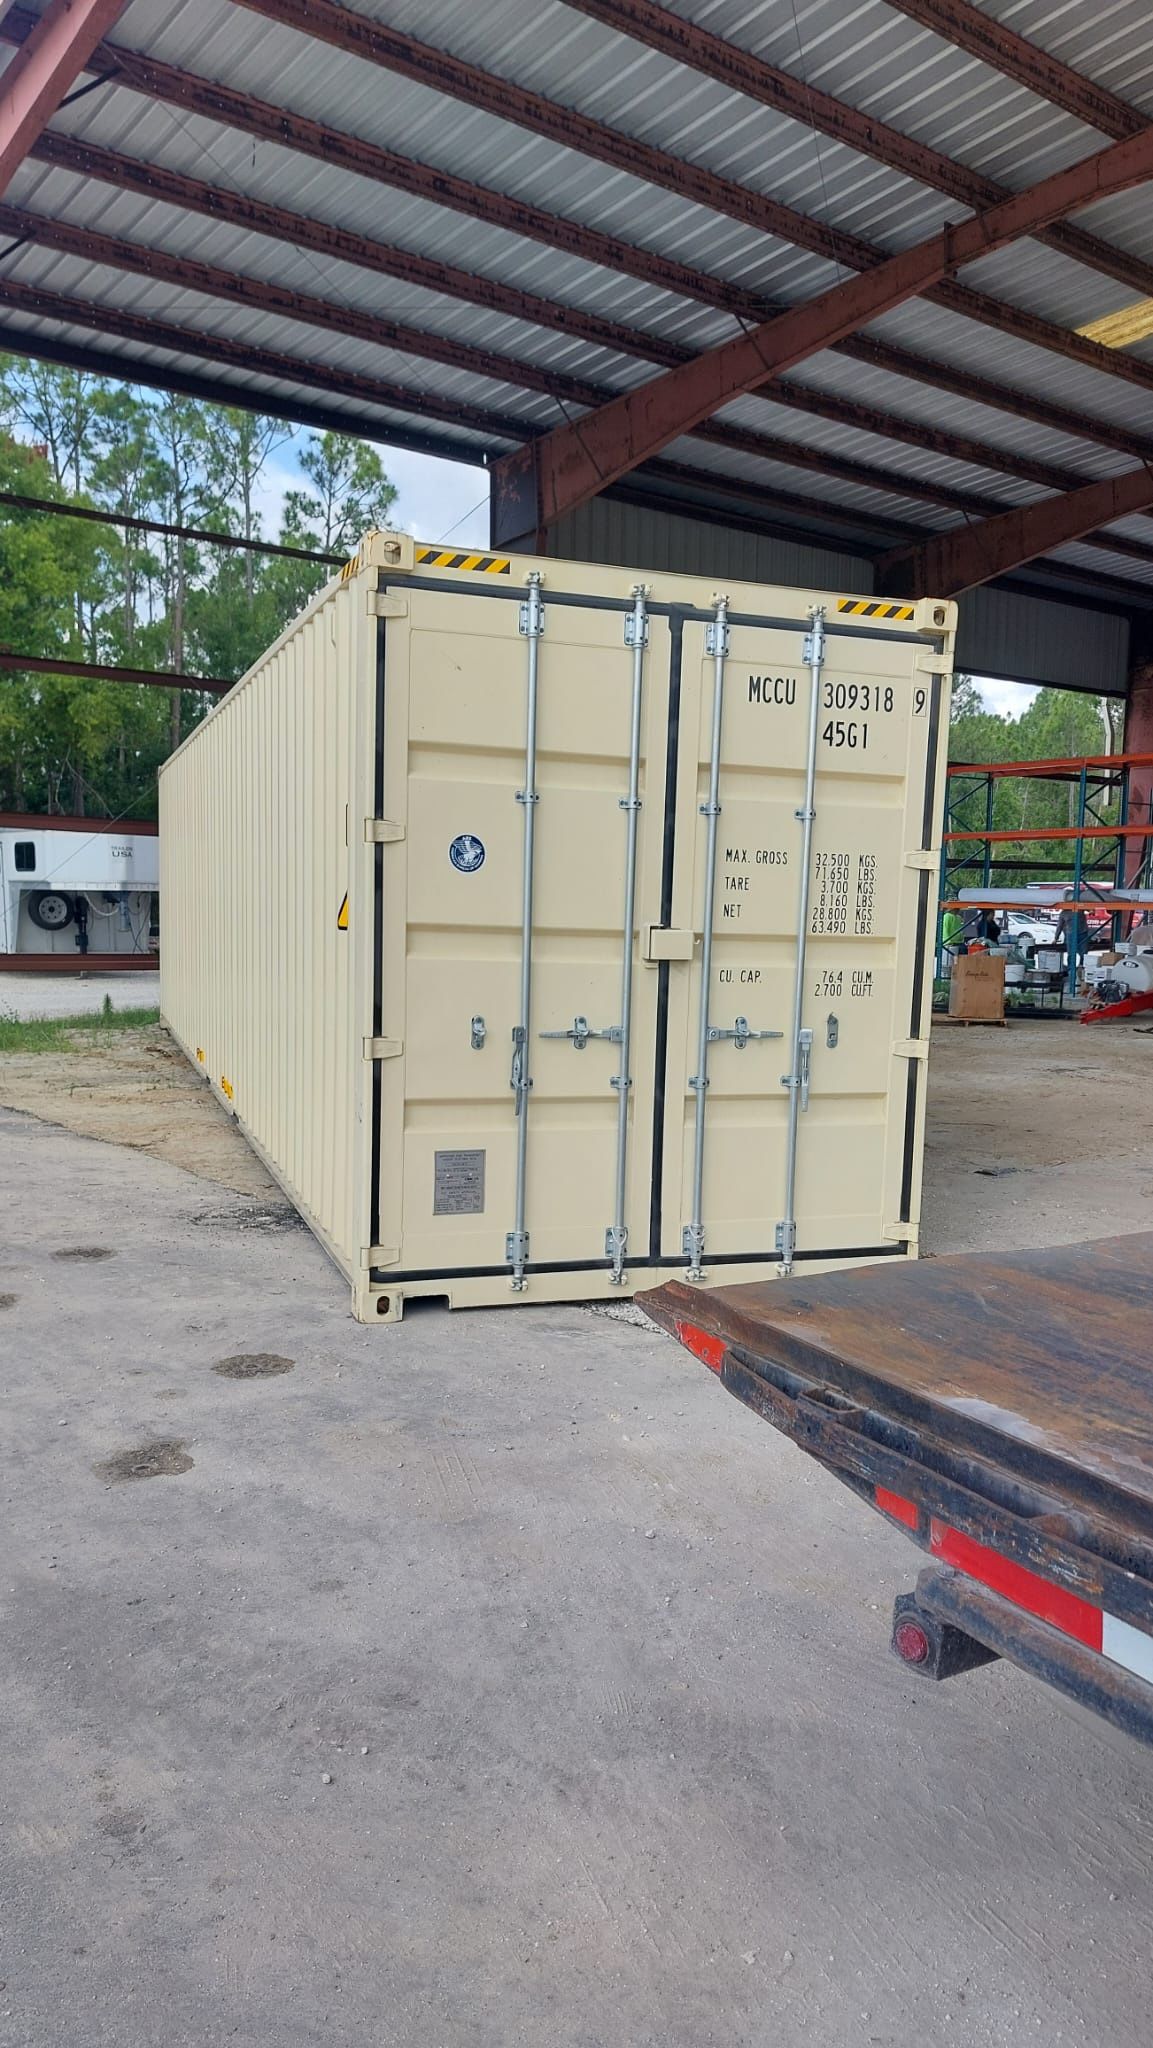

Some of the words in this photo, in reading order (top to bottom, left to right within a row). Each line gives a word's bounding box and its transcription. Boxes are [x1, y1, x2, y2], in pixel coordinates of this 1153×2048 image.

[748, 675, 796, 705] MCCU
[823, 682, 894, 713] 309318
[914, 689, 926, 714] 9
[822, 720, 868, 749] 45G1
[725, 847, 751, 864] MAX.
[755, 850, 788, 865] GROSS
[815, 853, 850, 867] 32.500
[859, 854, 878, 868] KGS.
[815, 866, 849, 880] 71.650
[858, 867, 877, 881] LBS.
[724, 876, 750, 891] TARE
[821, 880, 848, 894] 3.700
[857, 881, 876, 895] KGS.
[820, 894, 848, 907] 8.160
[856, 894, 875, 908] LBS.
[723, 903, 742, 918] NET
[812, 907, 847, 921] 28.800
[855, 907, 875, 921] KGS.
[811, 920, 846, 934] 63.490
[854, 921, 874, 935] LBS.
[719, 969, 734, 983] CU.
[740, 970, 762, 983] CAP.
[822, 970, 843, 984] 76.4
[814, 983, 842, 997] 2.700
